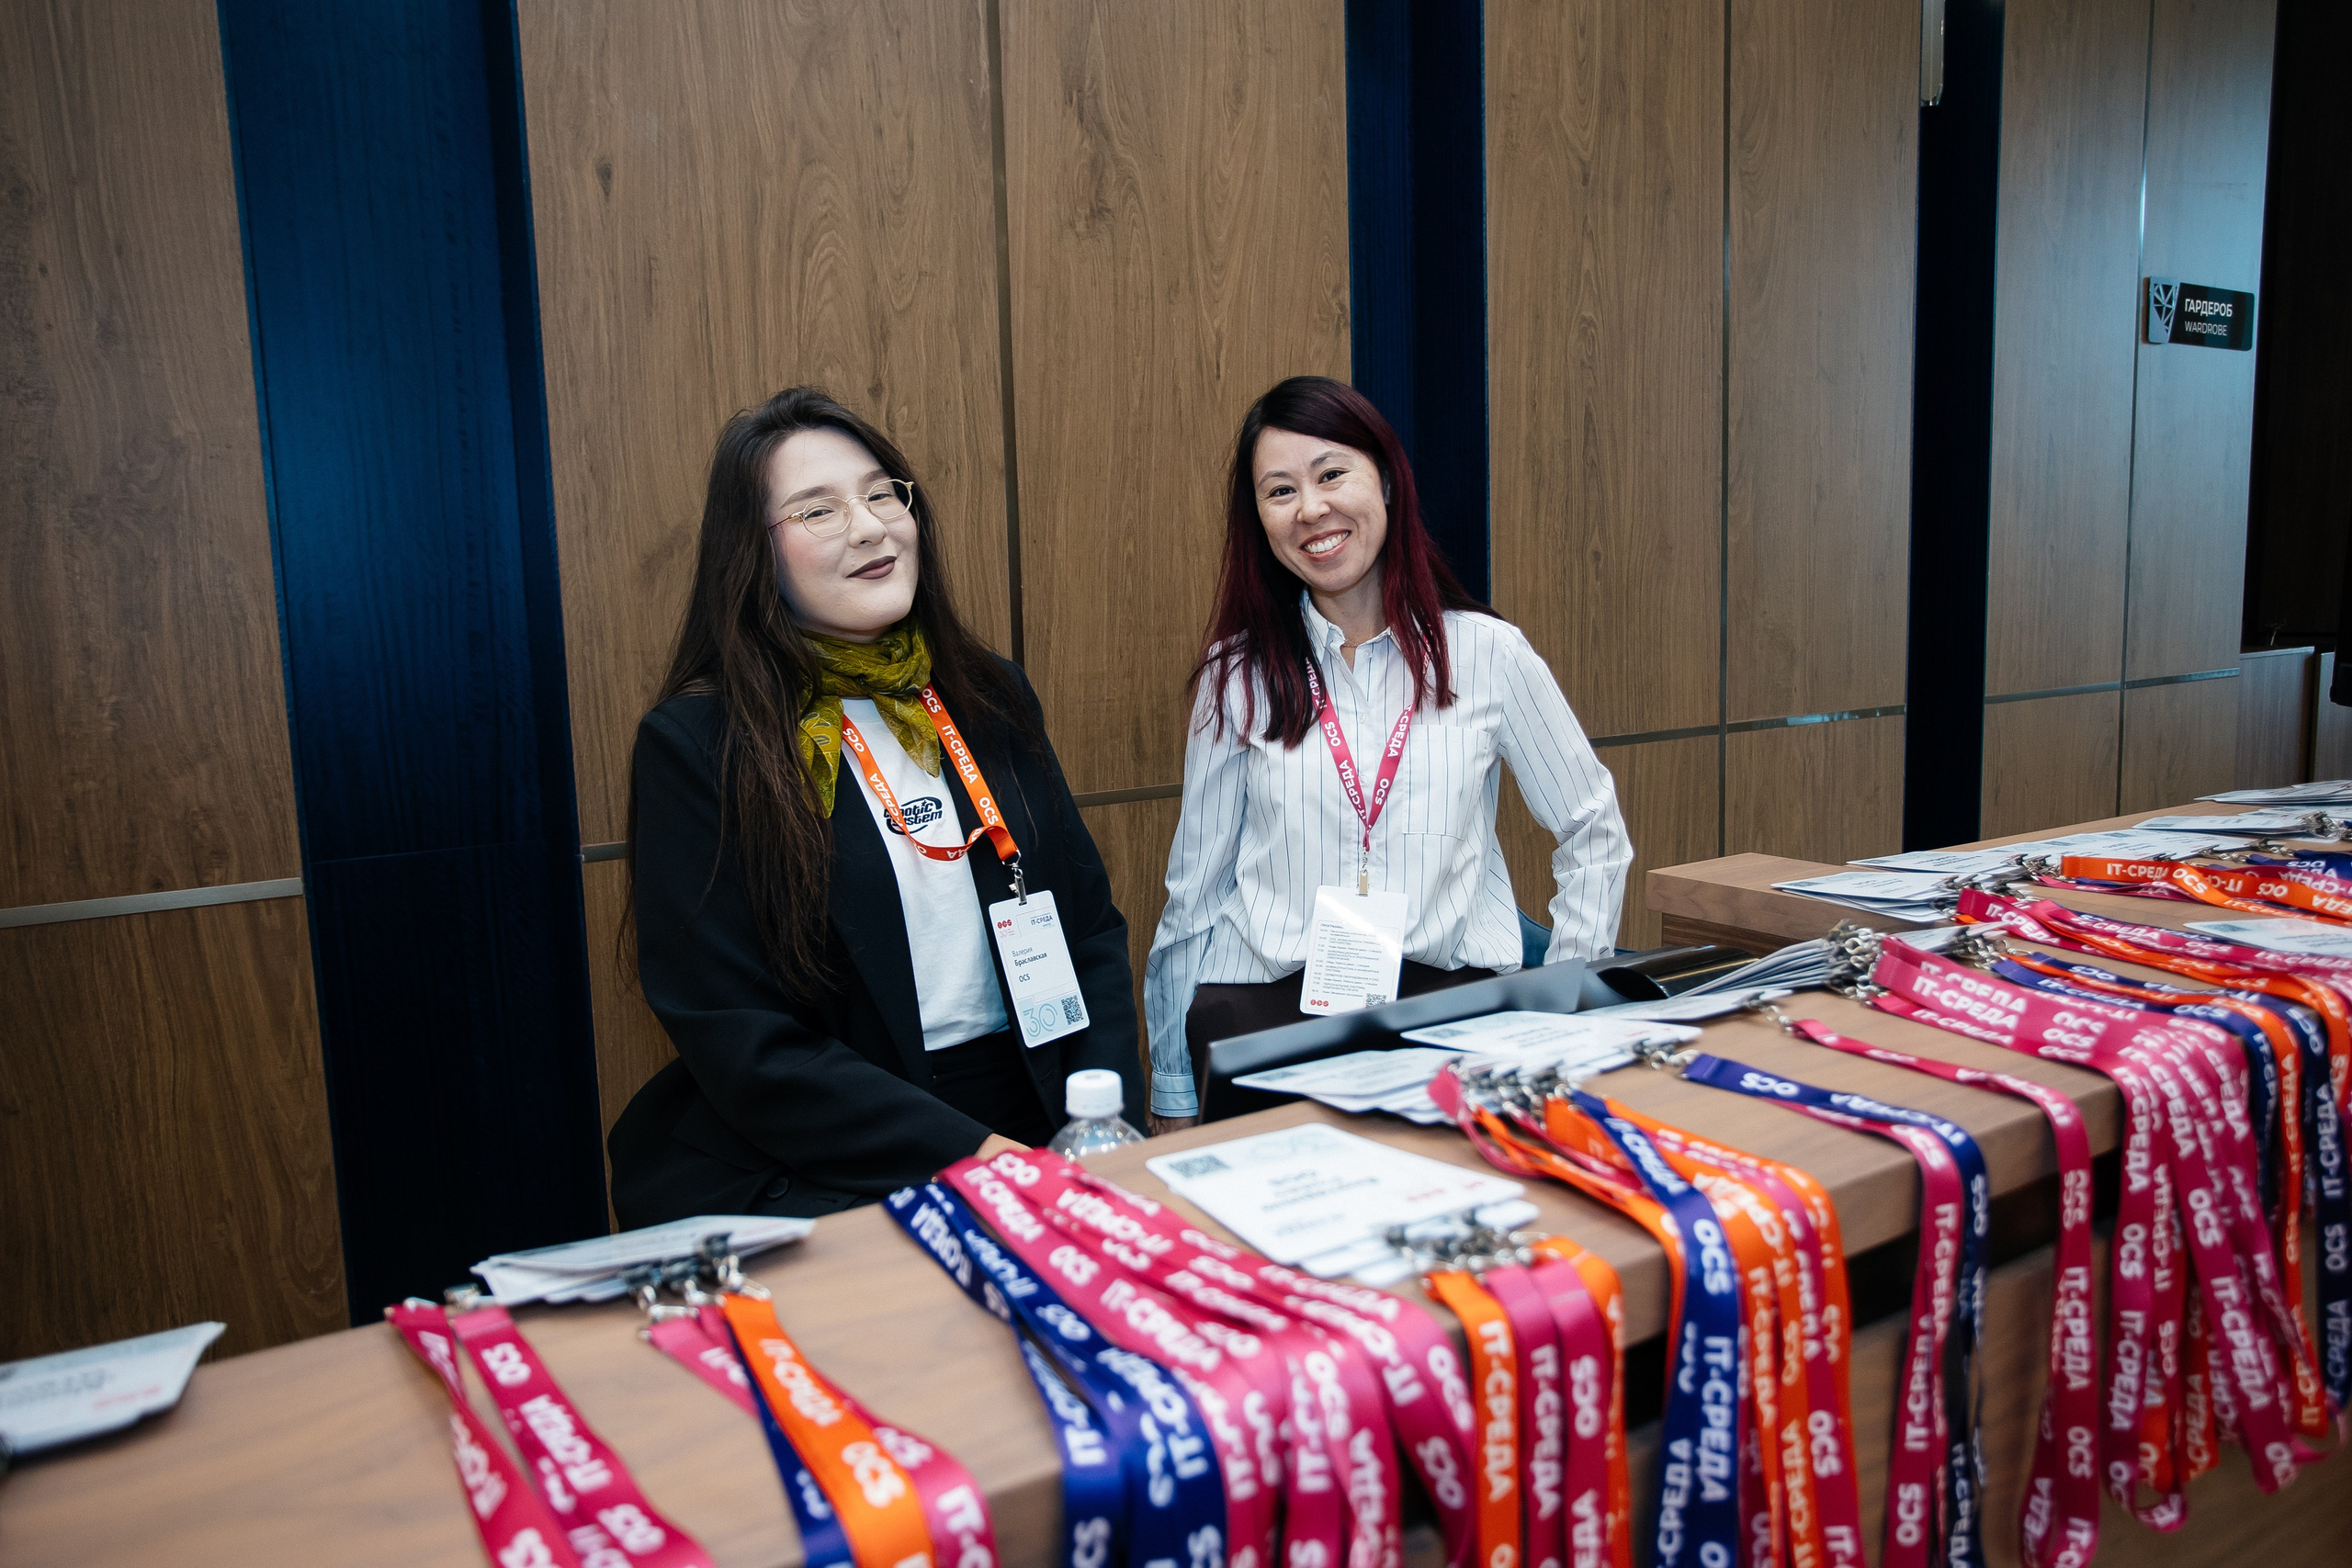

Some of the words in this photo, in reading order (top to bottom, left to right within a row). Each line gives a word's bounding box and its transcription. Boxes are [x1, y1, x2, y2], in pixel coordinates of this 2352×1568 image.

[2185, 299, 2233, 317] ГАРДЕРОБ
[2185, 321, 2227, 336] WARDROBE
[922, 688, 942, 714] OCS
[843, 728, 865, 753] OCS
[942, 725, 978, 784] IT-СРЕДА
[1324, 721, 1341, 747] OCS
[1387, 702, 1414, 758] T-СРЕДА
[869, 773, 904, 827] T-СРЕДА
[978, 796, 999, 825] OCS
[1374, 778, 1390, 806] OCS
[2172, 868, 2209, 894] OCS
[2256, 883, 2289, 898] OCS
[1985, 903, 2061, 944] IT-СРЕДА
[1019, 974, 1031, 983] OCS
[1912, 976, 2018, 1030] IT-СРЕДА
[1911, 1009, 2016, 1046] IT-СРЕДА
[2041, 1028, 2098, 1049] OCS
[1739, 1071, 1801, 1098] OCS
[2316, 1082, 2344, 1199] IT-СРЕДА
[2188, 1187, 2225, 1248] OCS
[1692, 1218, 1734, 1296] OCS
[2120, 1223, 2148, 1280] OCS
[2324, 1223, 2348, 1272] OCS
[2064, 1266, 2092, 1392] IT-СРЕДА
[2210, 1275, 2273, 1411] IT-СРЕДА
[2109, 1309, 2147, 1432] IT-СРЕДА
[1695, 1335, 1735, 1504] IT-СРЕДА
[1807, 1409, 1843, 1479] OCS
[2066, 1426, 2093, 1480] OCS
[1657, 1437, 1693, 1568] -СРЕДА
[1895, 1481, 1927, 1548] OCS
